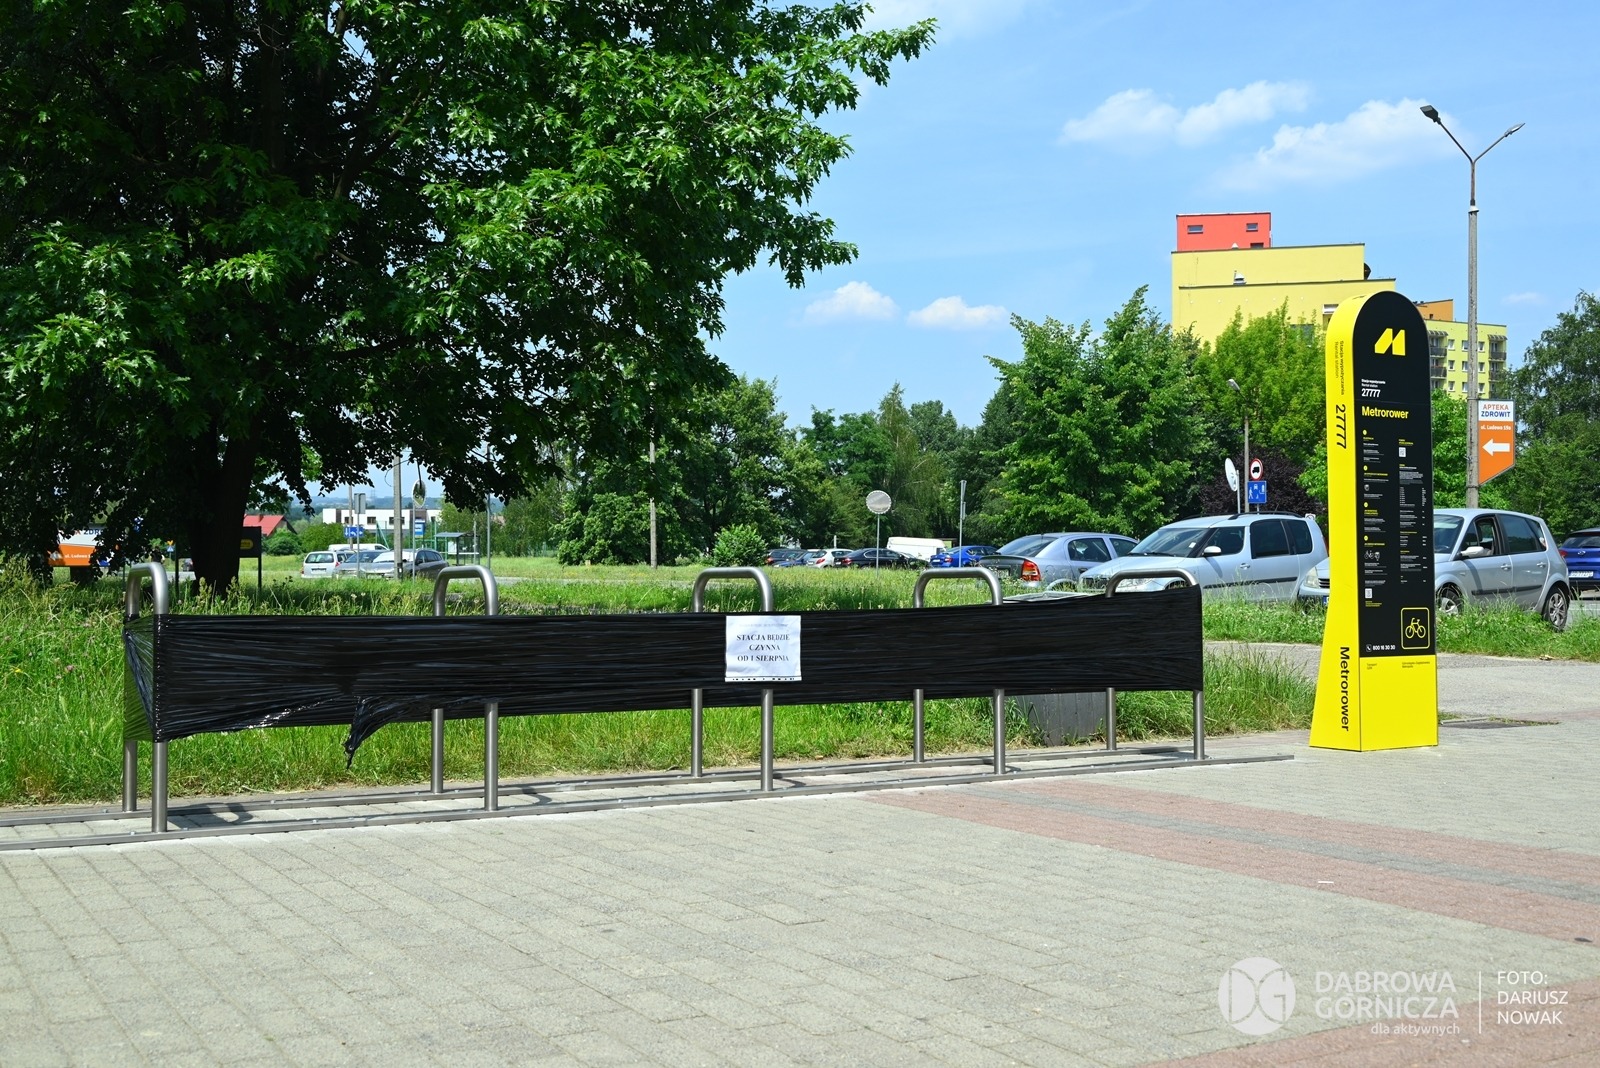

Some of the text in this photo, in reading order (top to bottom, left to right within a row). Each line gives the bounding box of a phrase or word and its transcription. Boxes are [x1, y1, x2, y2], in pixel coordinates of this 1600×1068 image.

[1362, 388, 1381, 398] 27777
[1362, 406, 1409, 419] Metrorower
[1336, 404, 1346, 449] 27777
[767, 634, 790, 642] BĘDZIE
[1340, 646, 1350, 731] Metrorower
